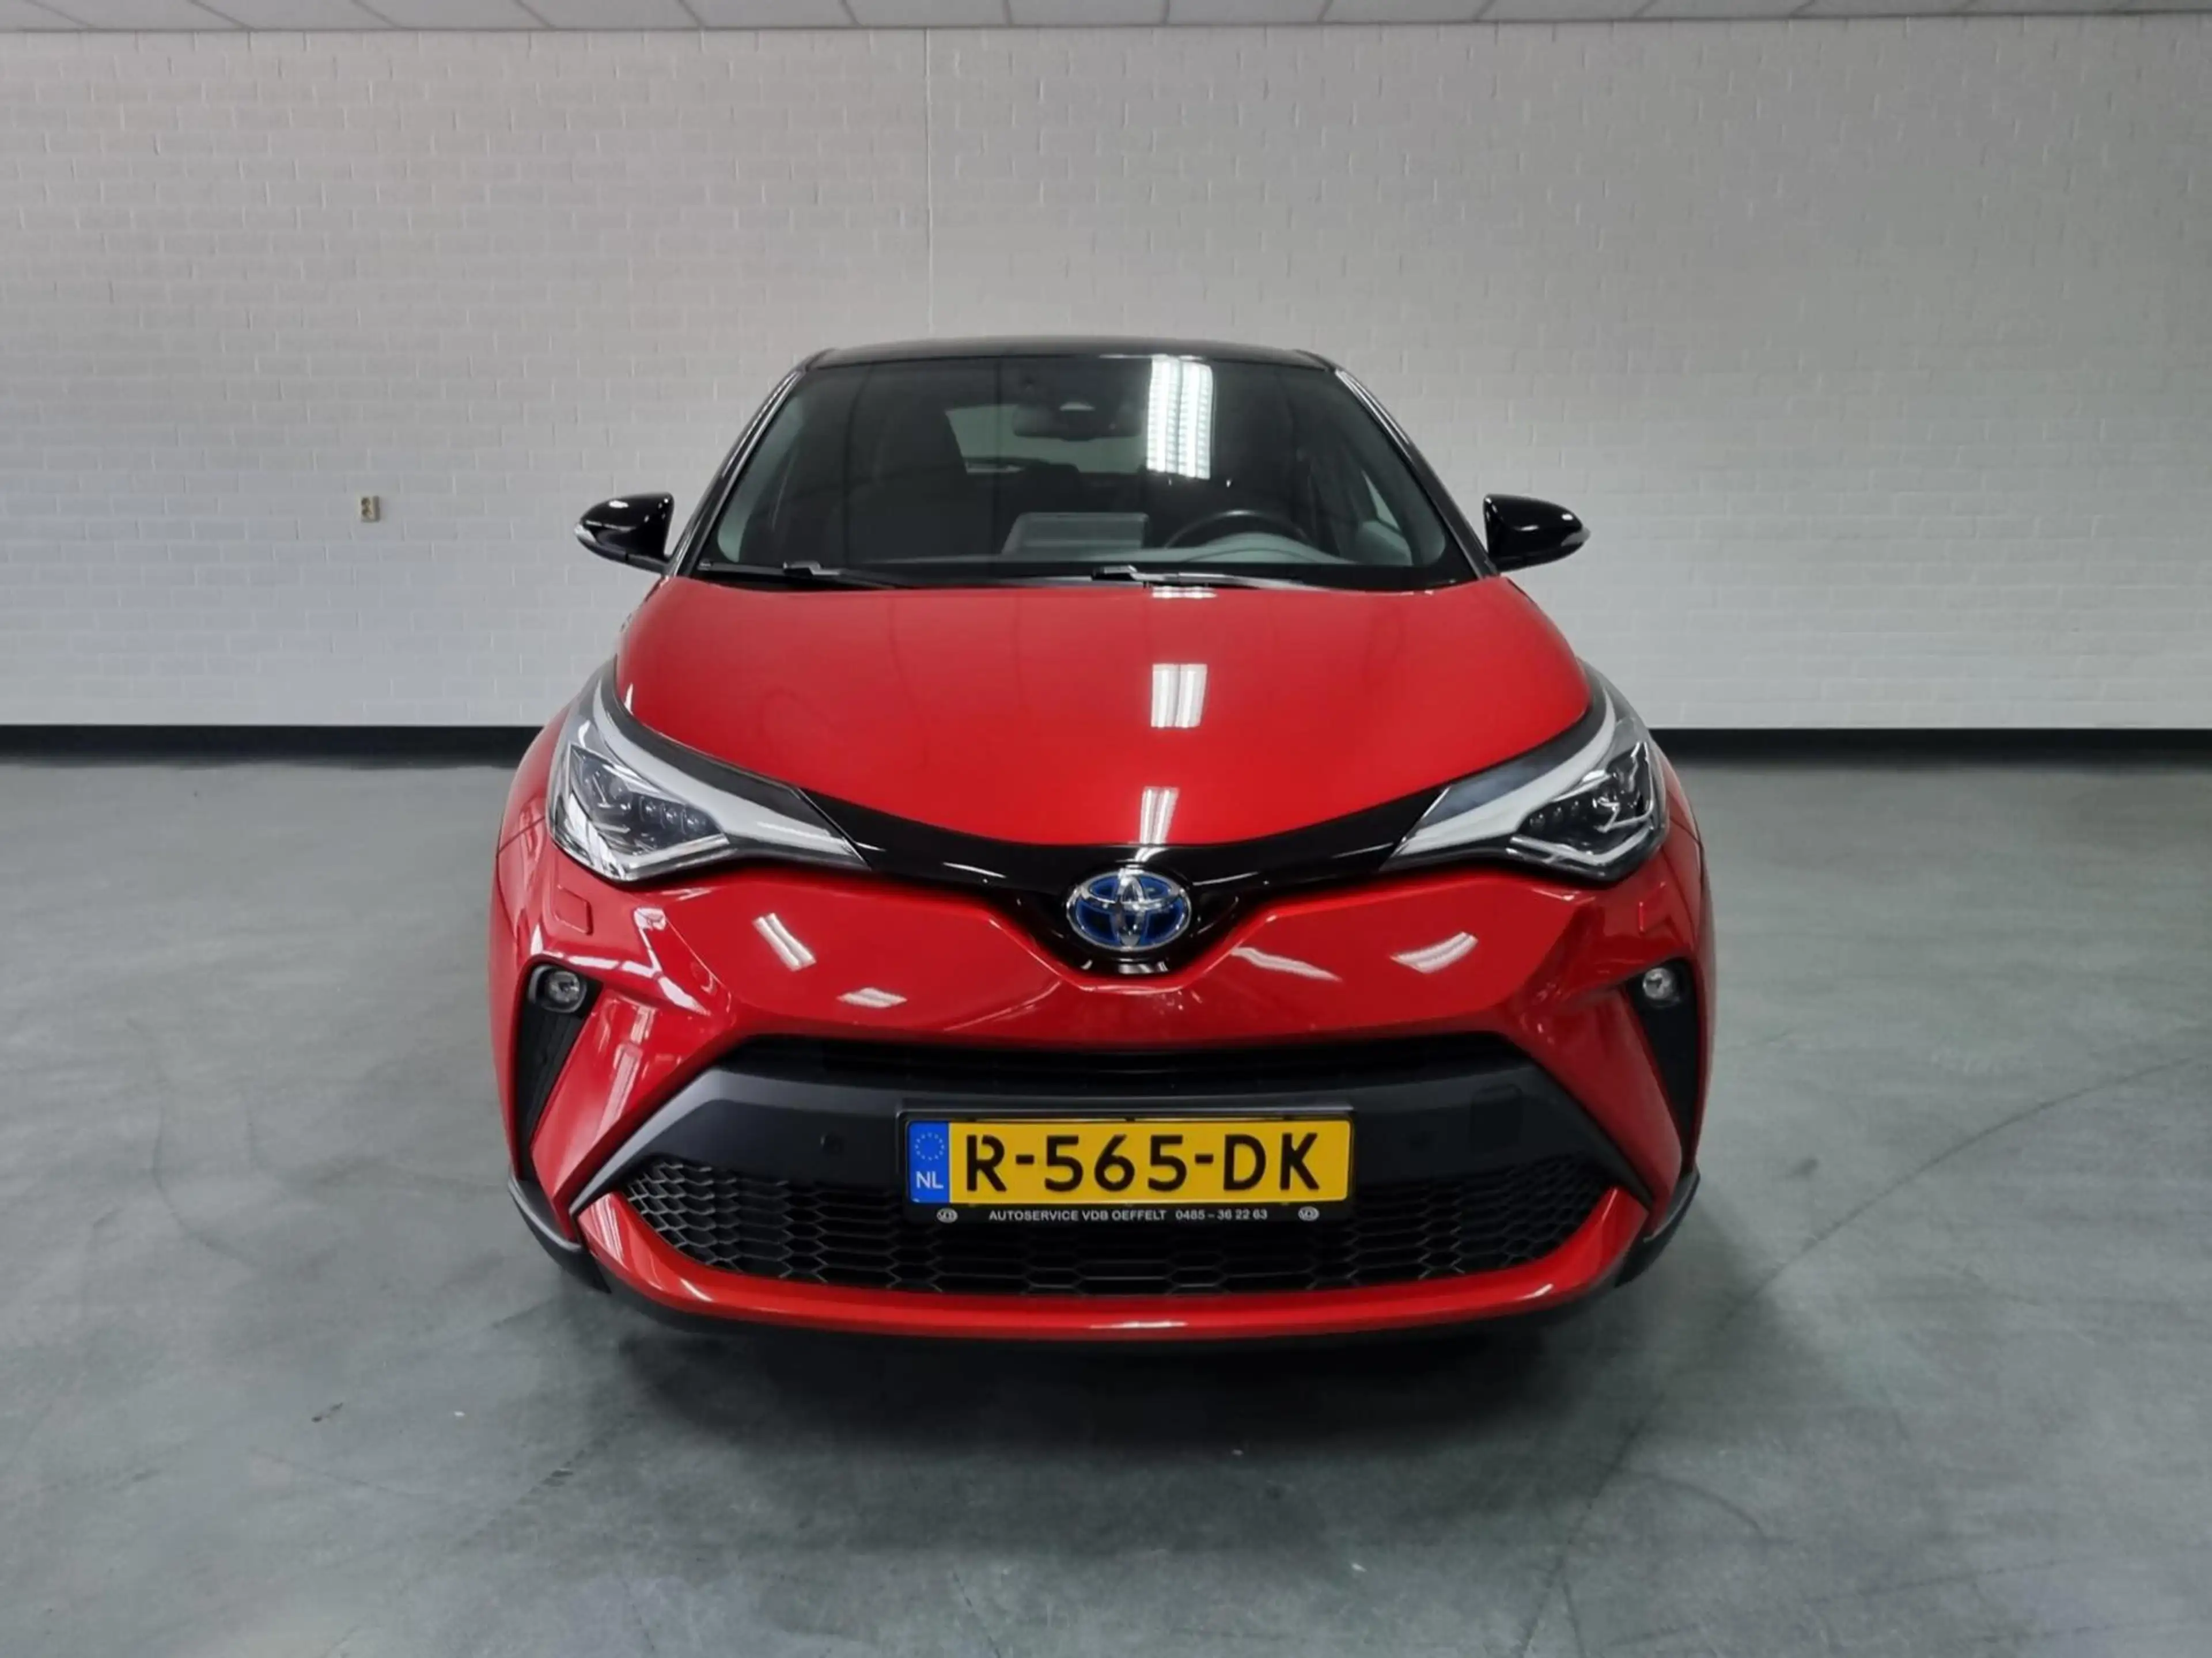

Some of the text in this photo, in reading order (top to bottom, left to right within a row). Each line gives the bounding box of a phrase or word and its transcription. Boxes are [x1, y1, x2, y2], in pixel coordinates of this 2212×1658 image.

[966, 1133, 1320, 1192] R-565-DK
[915, 1171, 944, 1189] NL
[989, 1211, 1079, 1220] AUTOSERVICE
[1082, 1211, 1108, 1220] VDB
[1112, 1210, 1166, 1220] OEFFELT
[1175, 1210, 1205, 1220] 0485
[1236, 1209, 1251, 1220] 22
